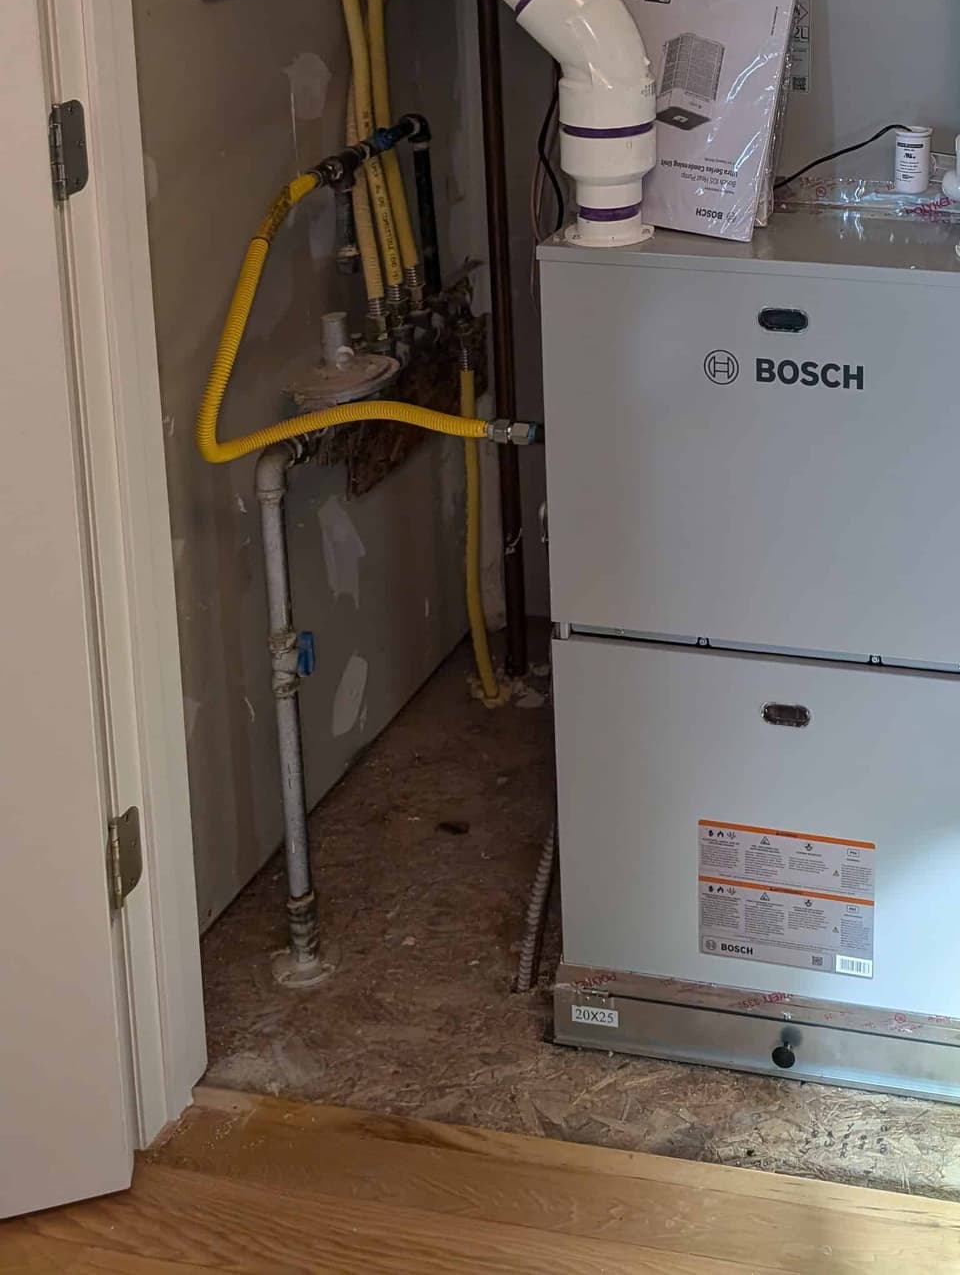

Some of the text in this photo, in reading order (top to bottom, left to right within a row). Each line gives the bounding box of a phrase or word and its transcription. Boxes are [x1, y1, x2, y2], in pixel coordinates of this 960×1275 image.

[695, 207, 723, 220] BOSCH
[755, 357, 864, 390] BOSCH
[720, 942, 754, 955] BOSCH
[575, 1008, 614, 1024] 20X25
